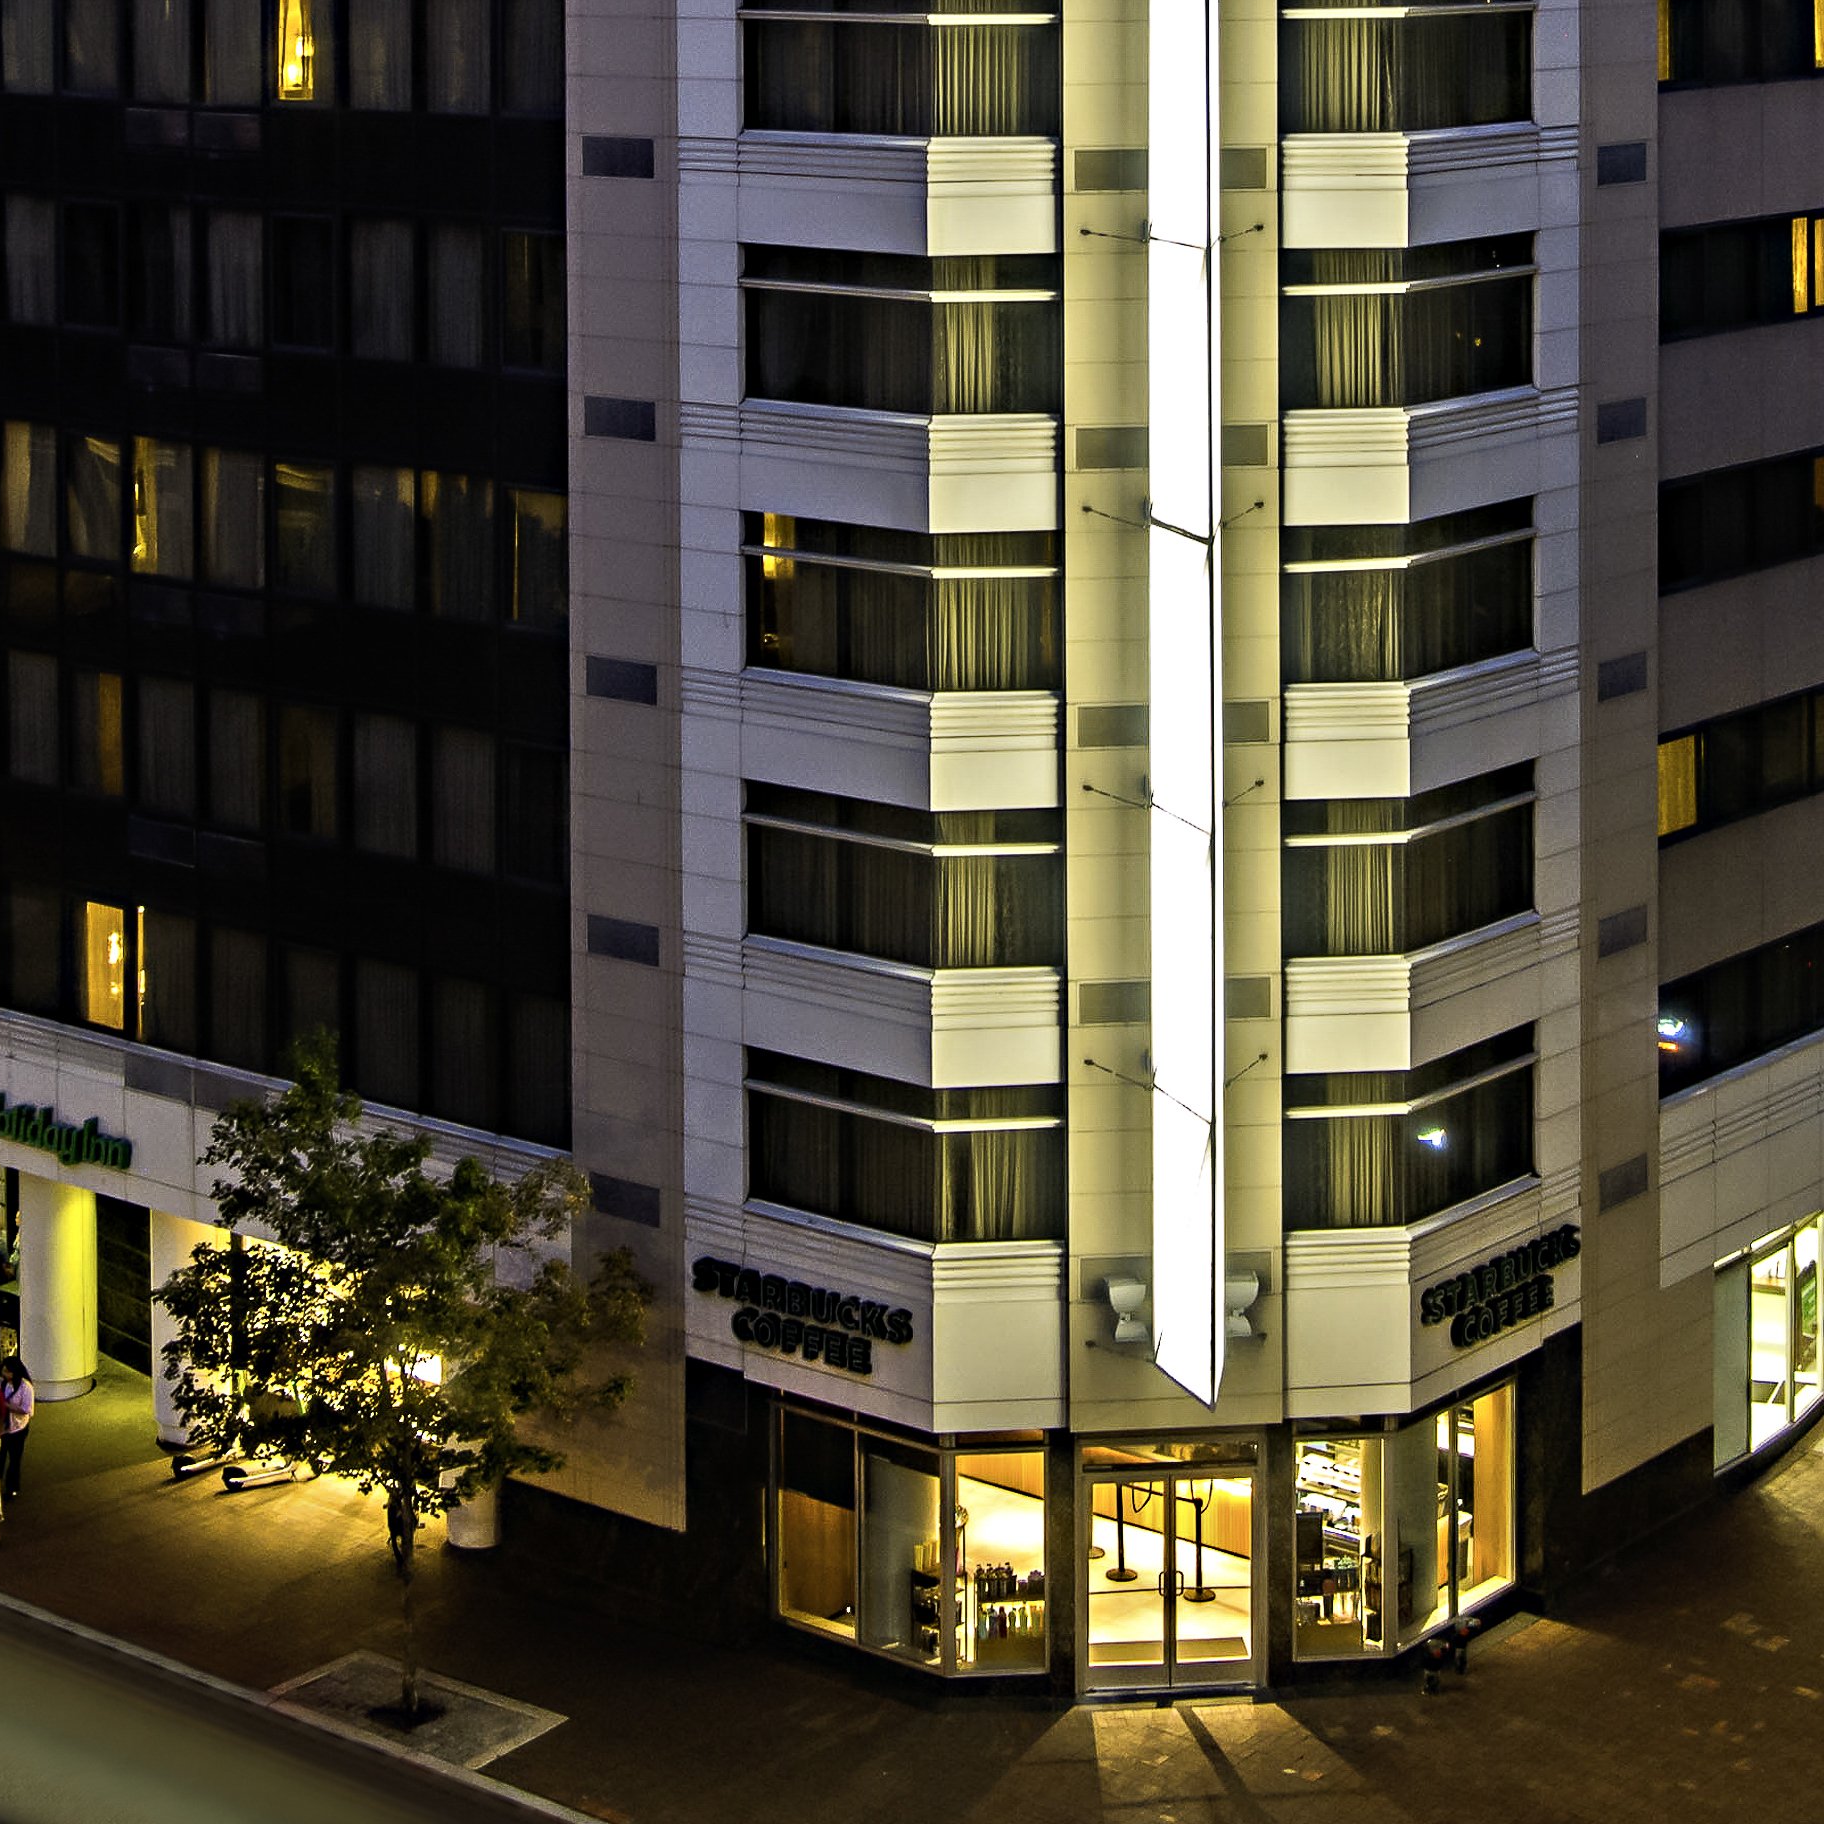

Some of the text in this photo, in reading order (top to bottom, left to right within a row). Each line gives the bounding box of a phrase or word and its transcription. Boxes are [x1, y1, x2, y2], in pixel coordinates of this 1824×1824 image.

[81, 1116, 133, 1170] Inn
[691, 1256, 914, 1345] STARBUCKS
[1420, 1224, 1581, 1326] STARBUCKS
[1450, 1274, 1555, 1348] COFFEE
[731, 1306, 873, 1376] COFFEE
